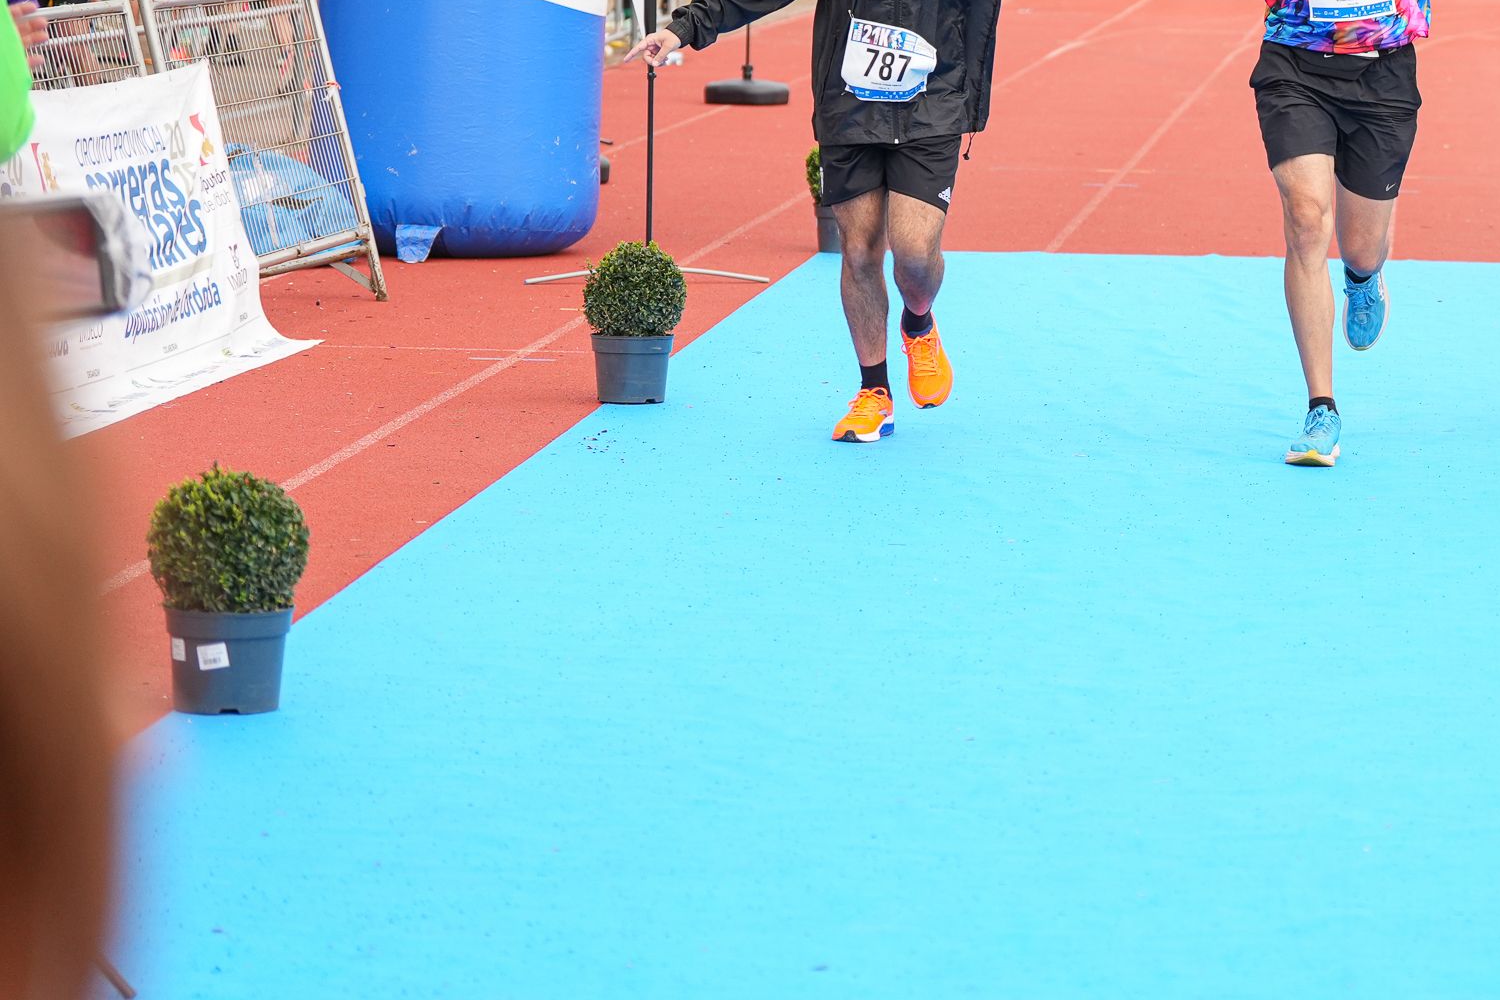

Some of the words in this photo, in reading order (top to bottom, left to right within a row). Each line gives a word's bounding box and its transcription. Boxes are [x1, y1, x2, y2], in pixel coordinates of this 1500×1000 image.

[864, 48, 911, 82] 787
[75, 133, 112, 167] CIRCUITO
[113, 125, 166, 158] PROVINCIAL
